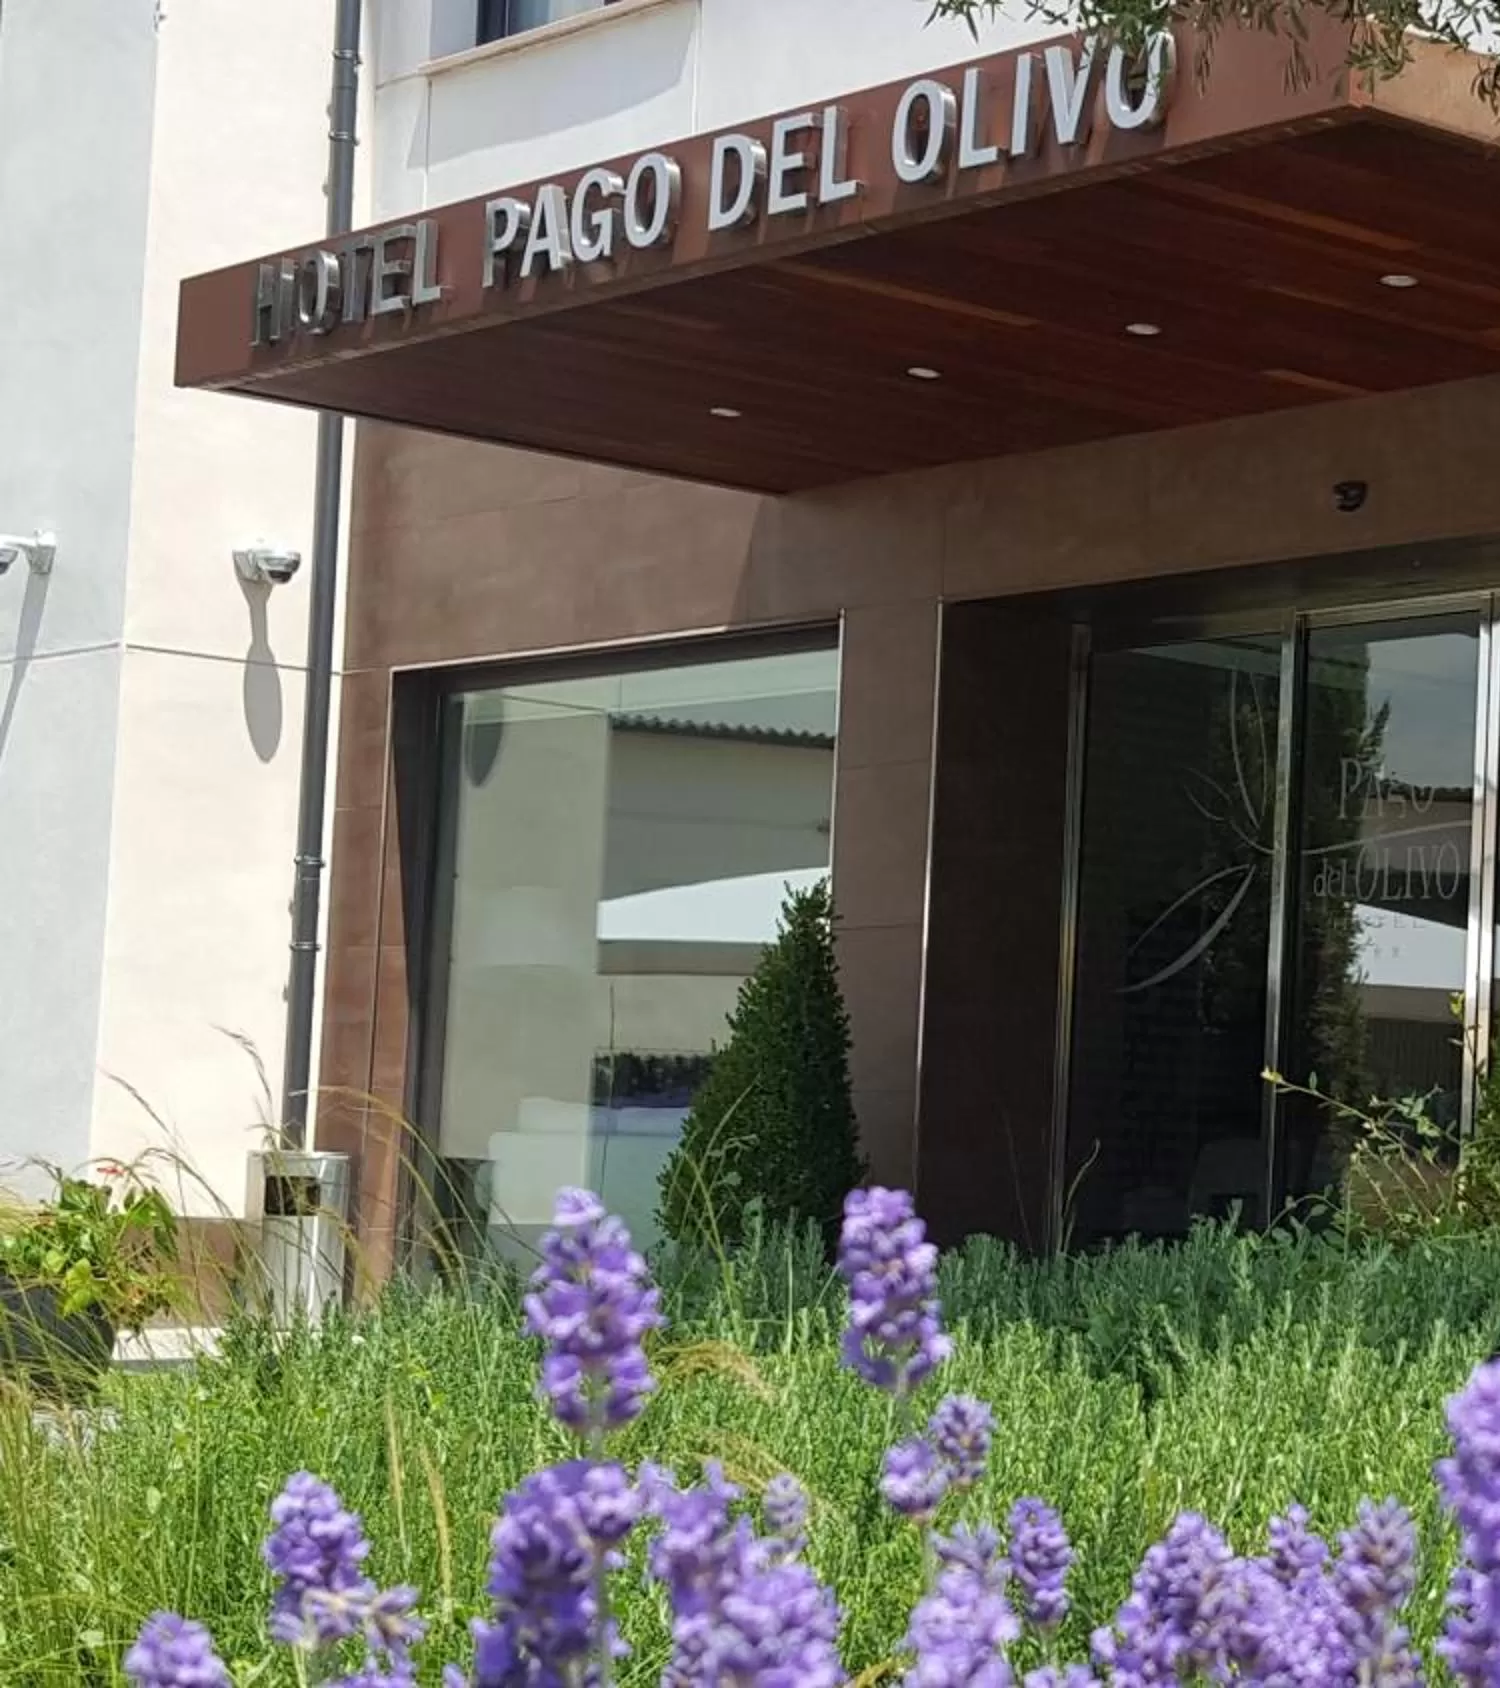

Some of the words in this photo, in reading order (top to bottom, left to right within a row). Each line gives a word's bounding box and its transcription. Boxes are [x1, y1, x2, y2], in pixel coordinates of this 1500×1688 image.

[251, 218, 443, 347] HOTEL
[482, 152, 682, 289] PAGO
[708, 106, 862, 232] DEL
[891, 28, 1177, 183] OLIVO
[1313, 857, 1348, 898] del
[1355, 840, 1461, 901] OLIVO
